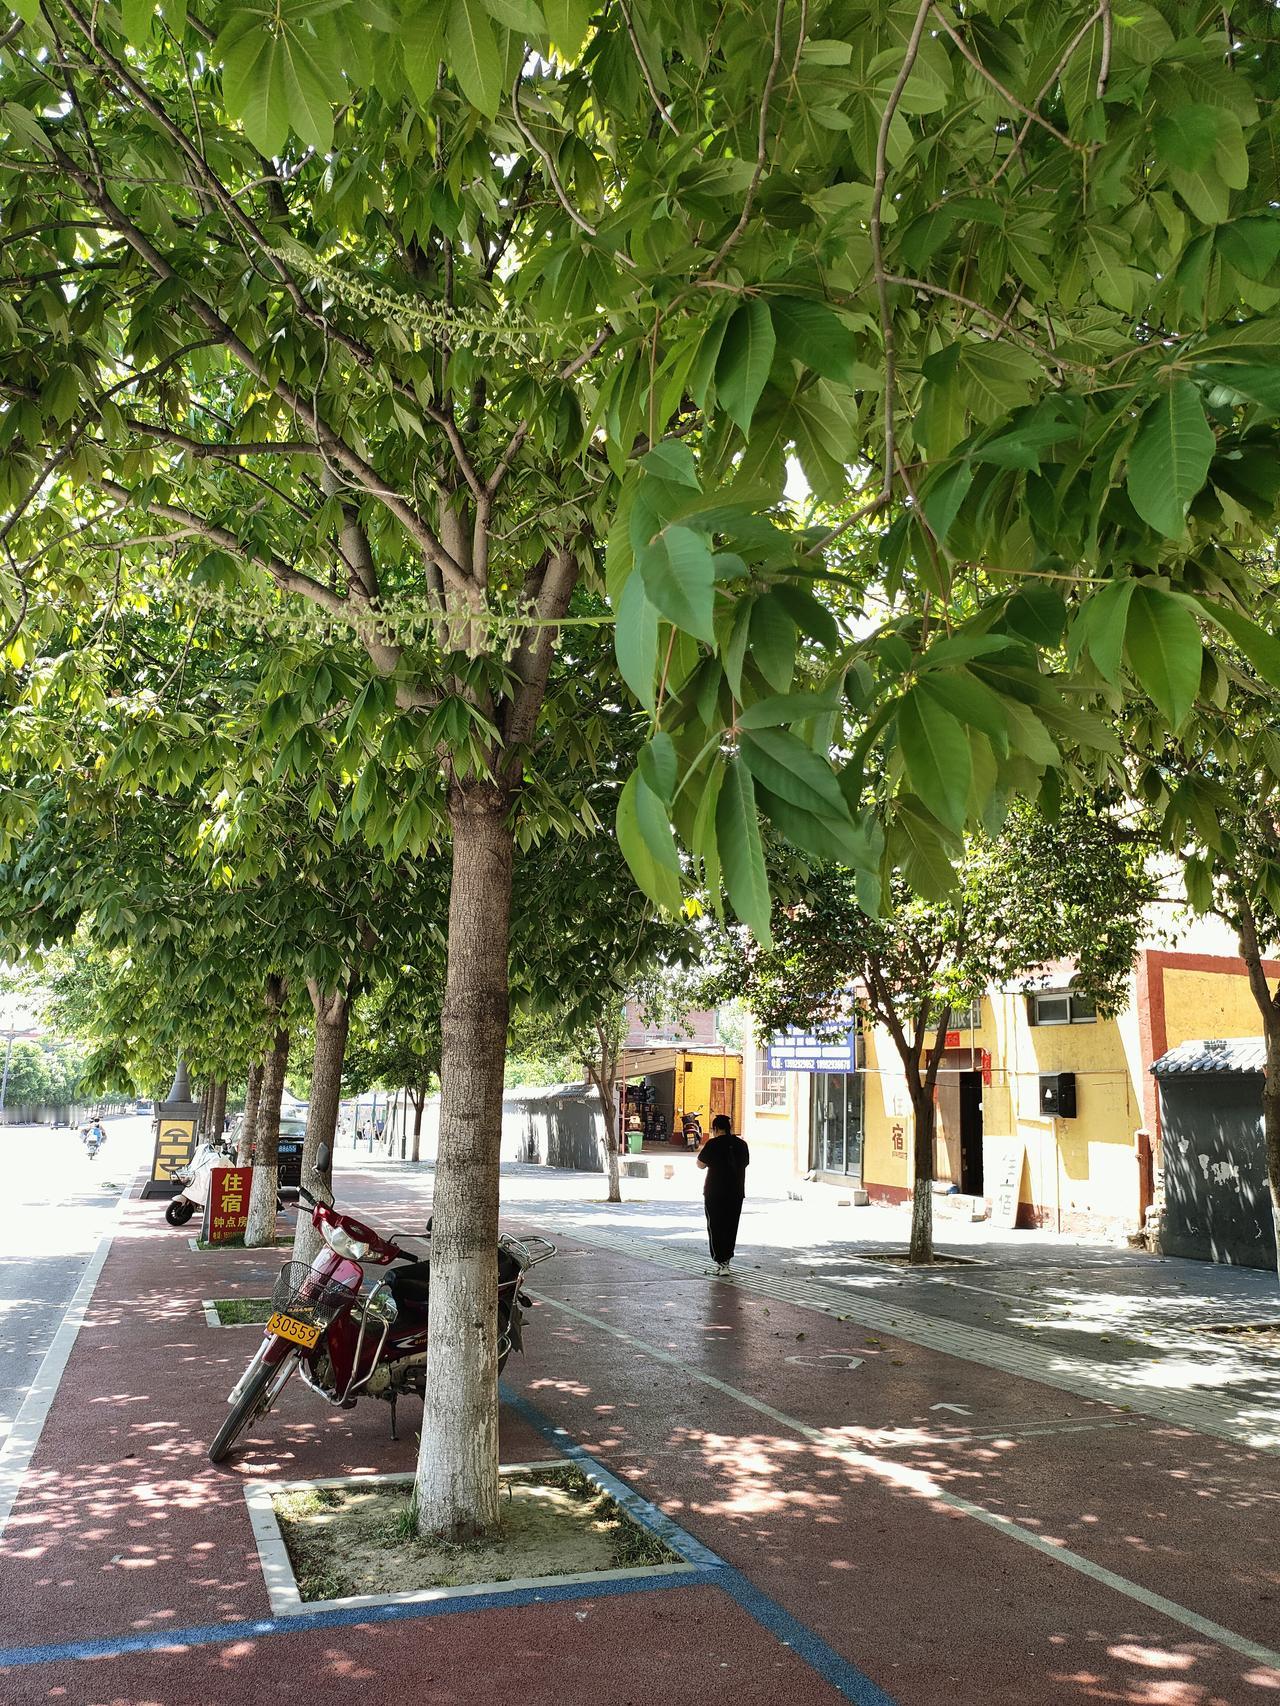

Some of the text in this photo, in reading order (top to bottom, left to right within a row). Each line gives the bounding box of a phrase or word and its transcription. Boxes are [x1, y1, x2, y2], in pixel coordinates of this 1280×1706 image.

[221, 1173, 243, 1213] 住宿
[213, 1216, 248, 1228] 钟点房
[272, 1316, 316, 1342] 30559
